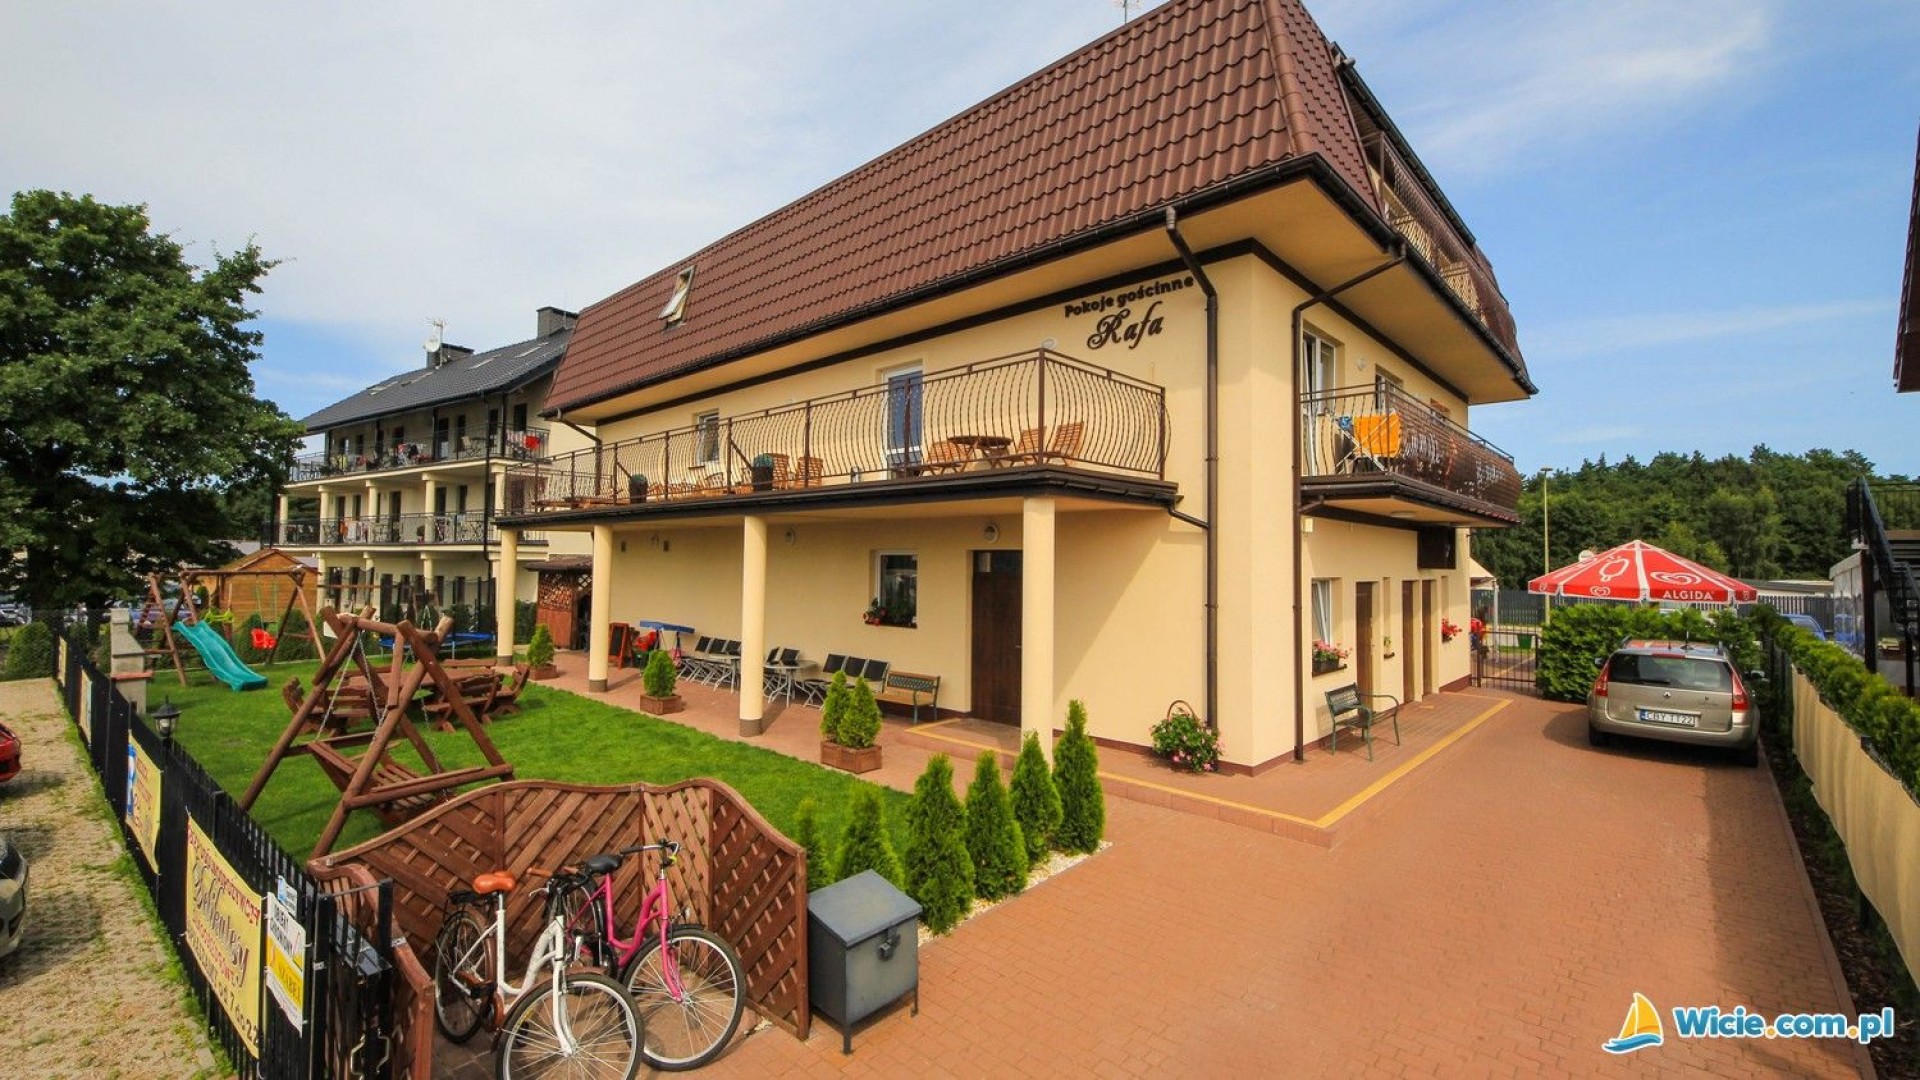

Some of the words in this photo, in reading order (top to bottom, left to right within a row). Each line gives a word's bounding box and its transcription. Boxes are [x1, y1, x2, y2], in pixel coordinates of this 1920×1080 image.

[1064, 295, 1114, 318] Pokoje
[1116, 275, 1195, 308] gościnne
[1662, 589, 1714, 601] ALGIDA
